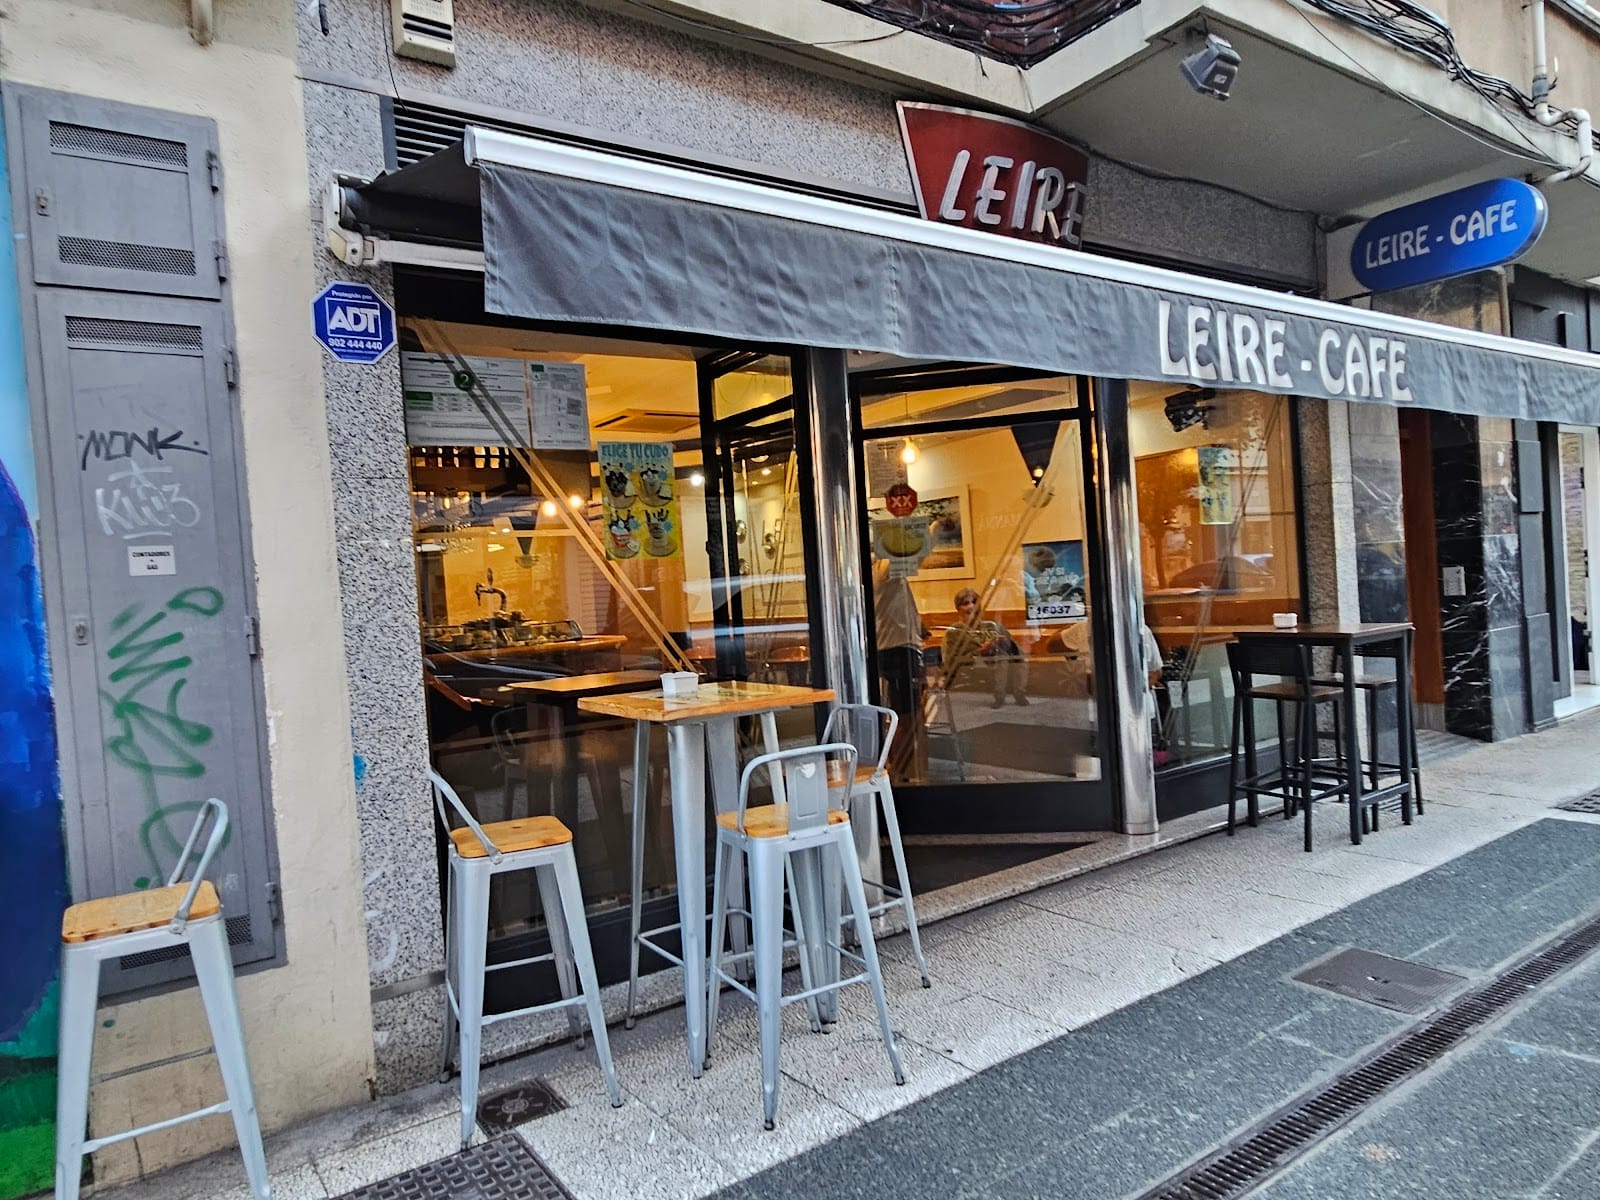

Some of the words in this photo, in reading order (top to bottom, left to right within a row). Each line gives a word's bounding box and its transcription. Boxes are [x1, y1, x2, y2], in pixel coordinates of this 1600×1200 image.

[939, 150, 1087, 245] LEIRE
[1366, 225, 1430, 269] LEIRE
[1450, 200, 1518, 246] CAFE
[328, 338, 346, 348] 902
[347, 339, 364, 349] 444
[366, 341, 383, 350] 440
[329, 306, 380, 334] ADT
[1159, 299, 1294, 388] LEIRE
[1318, 328, 1413, 401] CAFE
